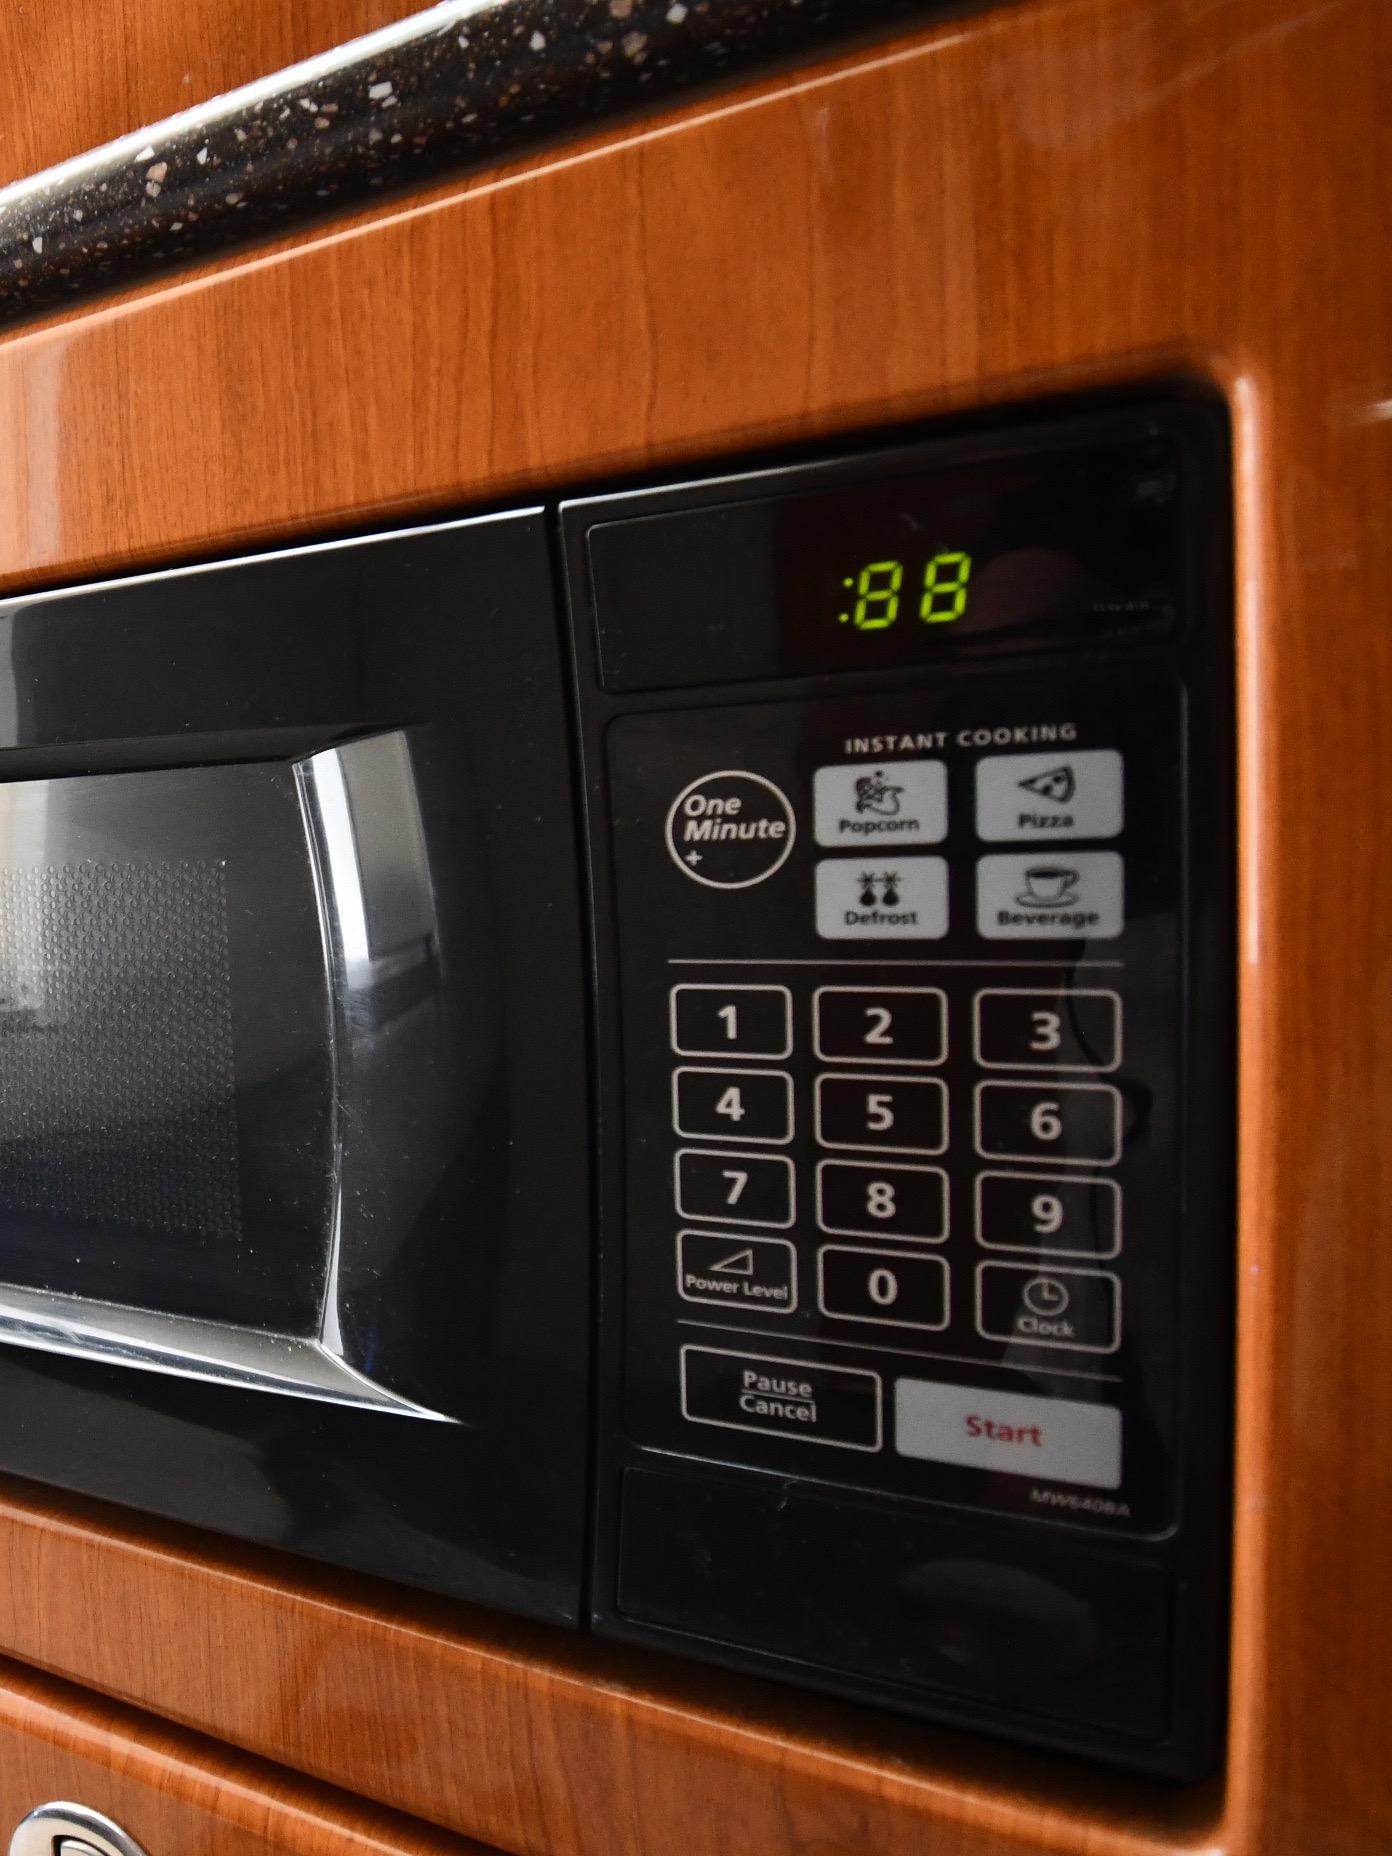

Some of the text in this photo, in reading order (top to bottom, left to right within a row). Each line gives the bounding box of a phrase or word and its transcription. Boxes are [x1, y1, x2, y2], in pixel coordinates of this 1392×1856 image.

[844, 722, 1078, 754] INSTANT COOKING
[683, 793, 742, 817] One
[1018, 813, 1074, 829] Pizza
[683, 817, 786, 842] Minute
[839, 818, 920, 835] Popcorn
[844, 910, 918, 926] Defrost
[996, 910, 1100, 929] Beverage
[718, 1005, 737, 1039] 1
[865, 1008, 893, 1044] 2
[1031, 1012, 1061, 1050] 3
[716, 1087, 745, 1121] 4
[868, 1094, 893, 1130] 5
[1031, 1102, 1062, 1140] 6
[723, 1171, 747, 1204] 7
[867, 1182, 895, 1218] 8
[1032, 1195, 1063, 1233] 9
[685, 1273, 788, 1300] Power Level
[869, 1269, 897, 1304] 0
[1016, 1315, 1075, 1337] Clock
[742, 1369, 813, 1397] Pause
[739, 1395, 817, 1423] Cancel
[965, 1413, 1043, 1448] Start
